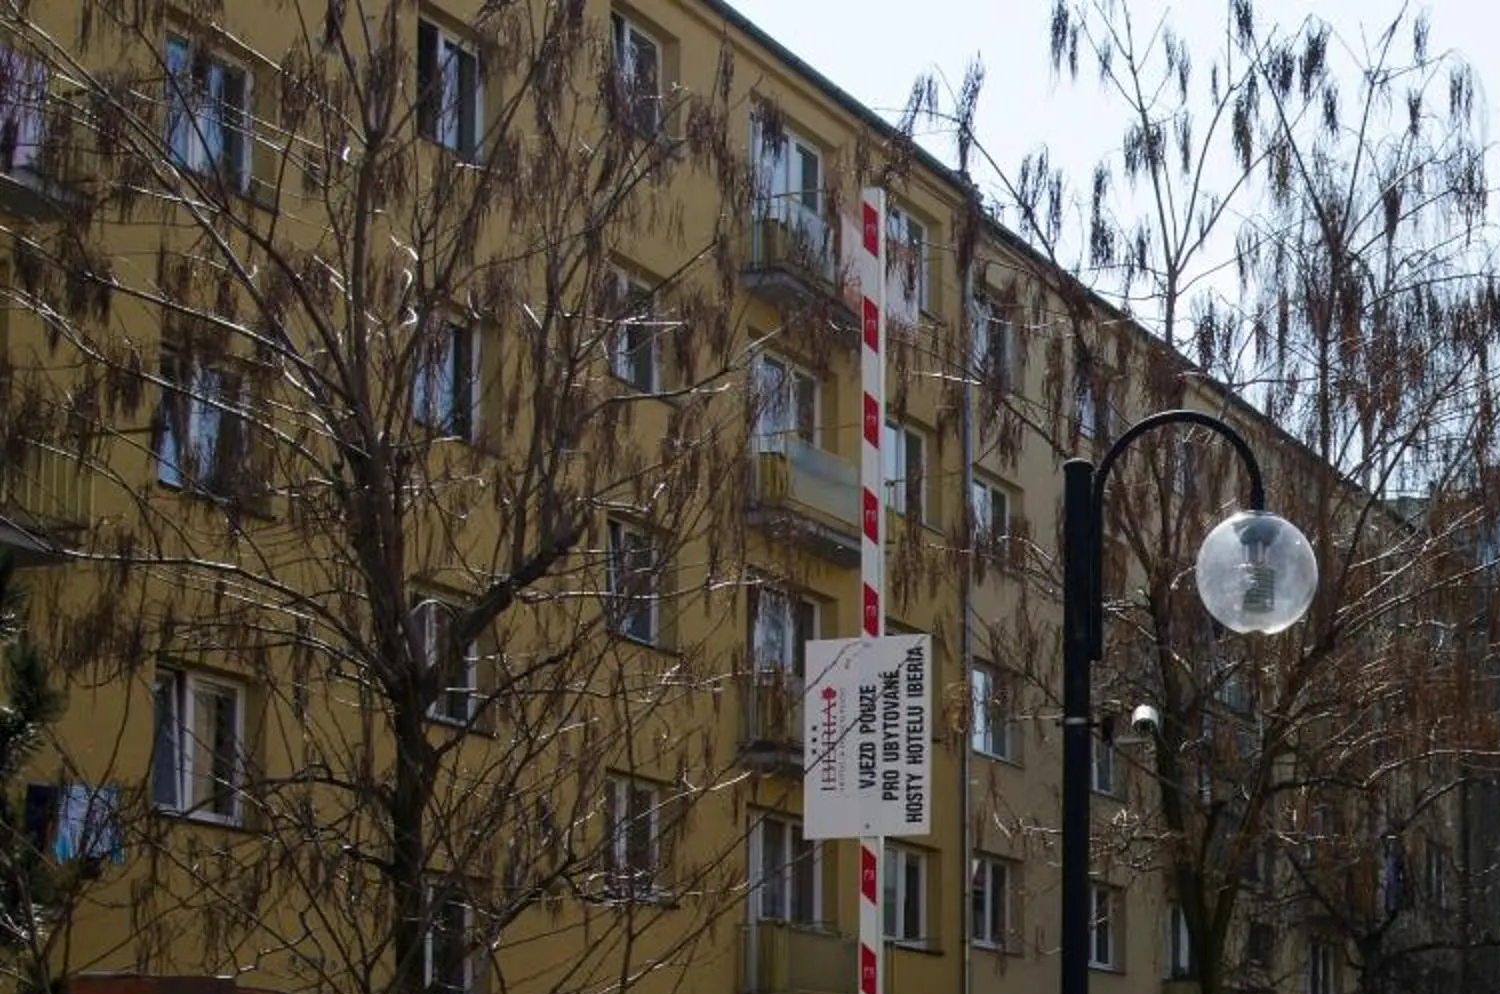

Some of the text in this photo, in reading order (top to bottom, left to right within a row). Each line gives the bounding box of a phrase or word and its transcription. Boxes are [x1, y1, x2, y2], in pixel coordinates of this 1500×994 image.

[858, 684, 877, 790] VJEZD POUZE
[878, 669, 900, 801] PRO UBYTOVANÉ
[905, 646, 925, 823] HOSTY HOTELU IBERIA
